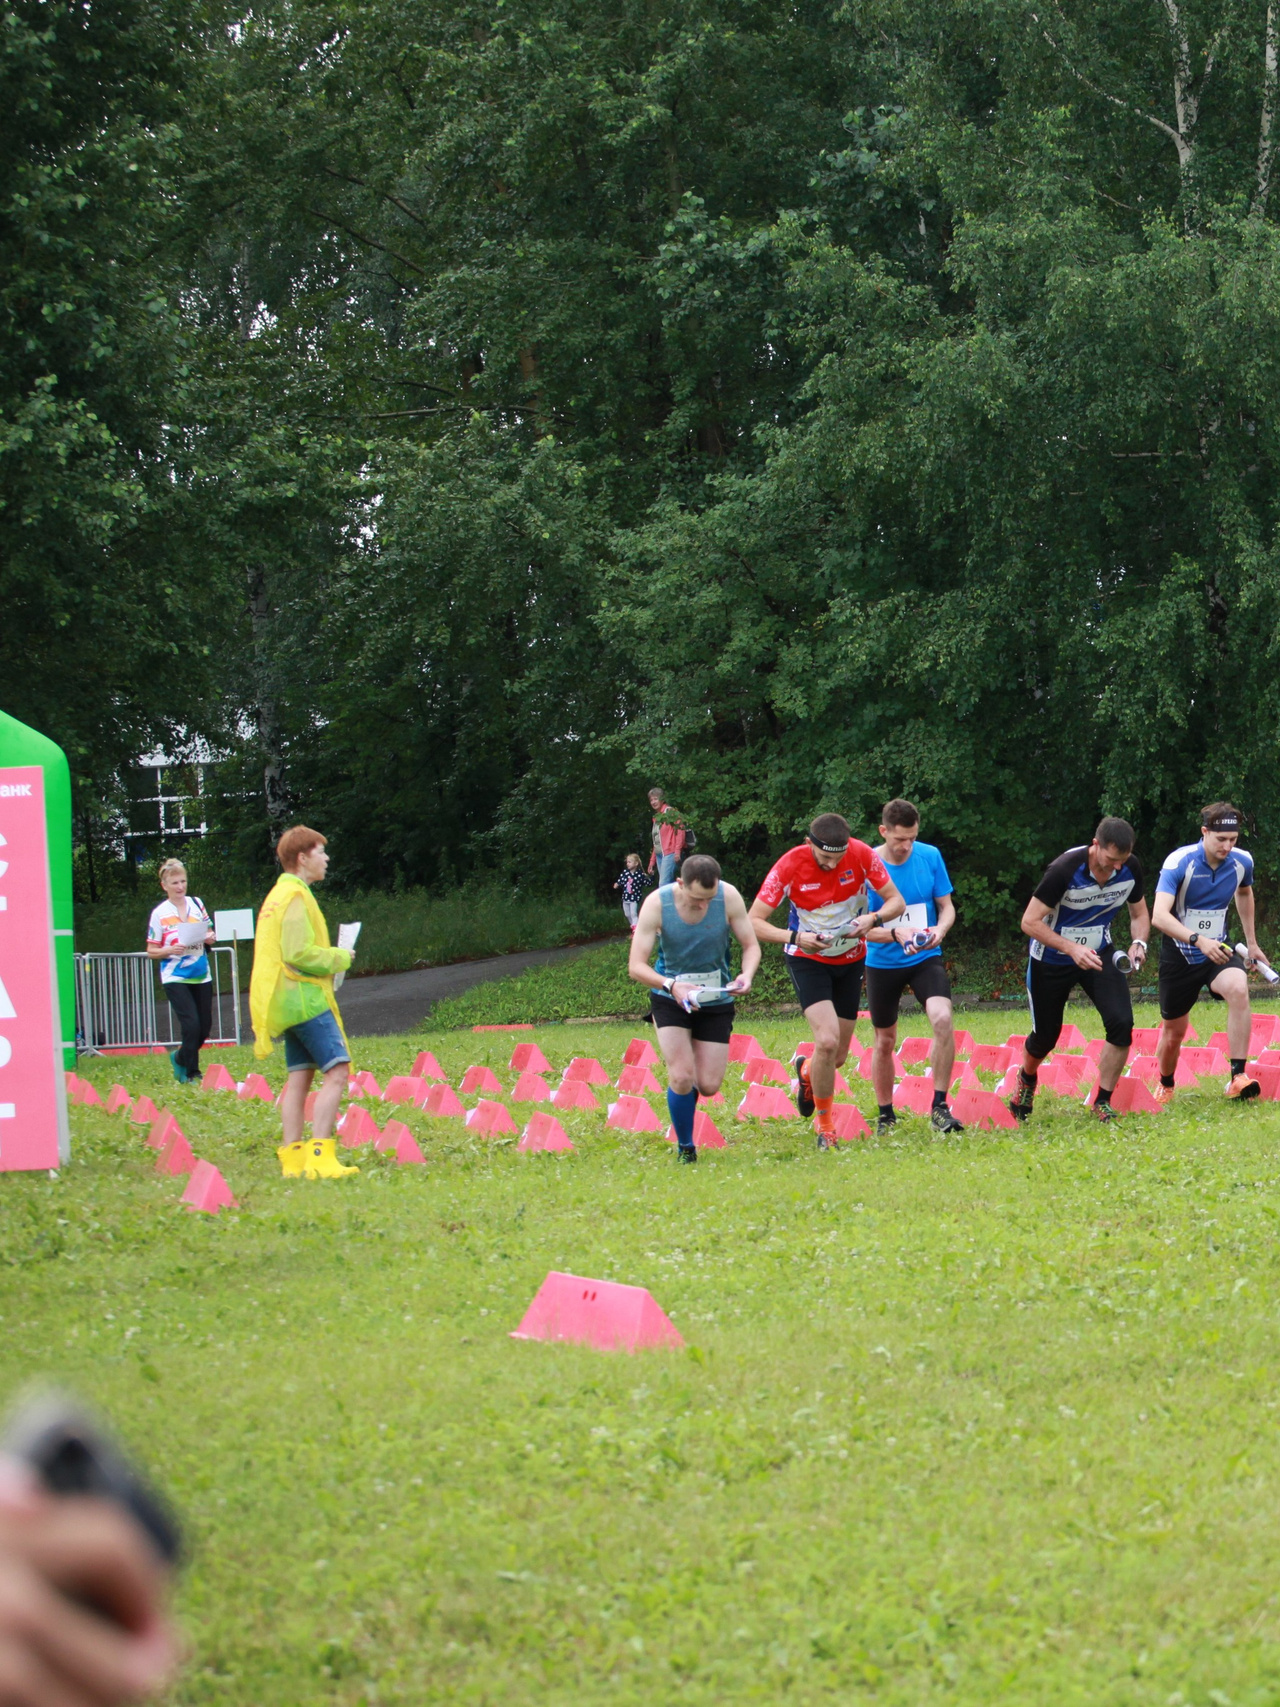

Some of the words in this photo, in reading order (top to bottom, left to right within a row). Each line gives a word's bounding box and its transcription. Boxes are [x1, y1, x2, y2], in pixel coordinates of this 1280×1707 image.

[0, 784, 32, 797] анк
[1198, 920, 1211, 930] 69
[1074, 936, 1087, 945] 70
